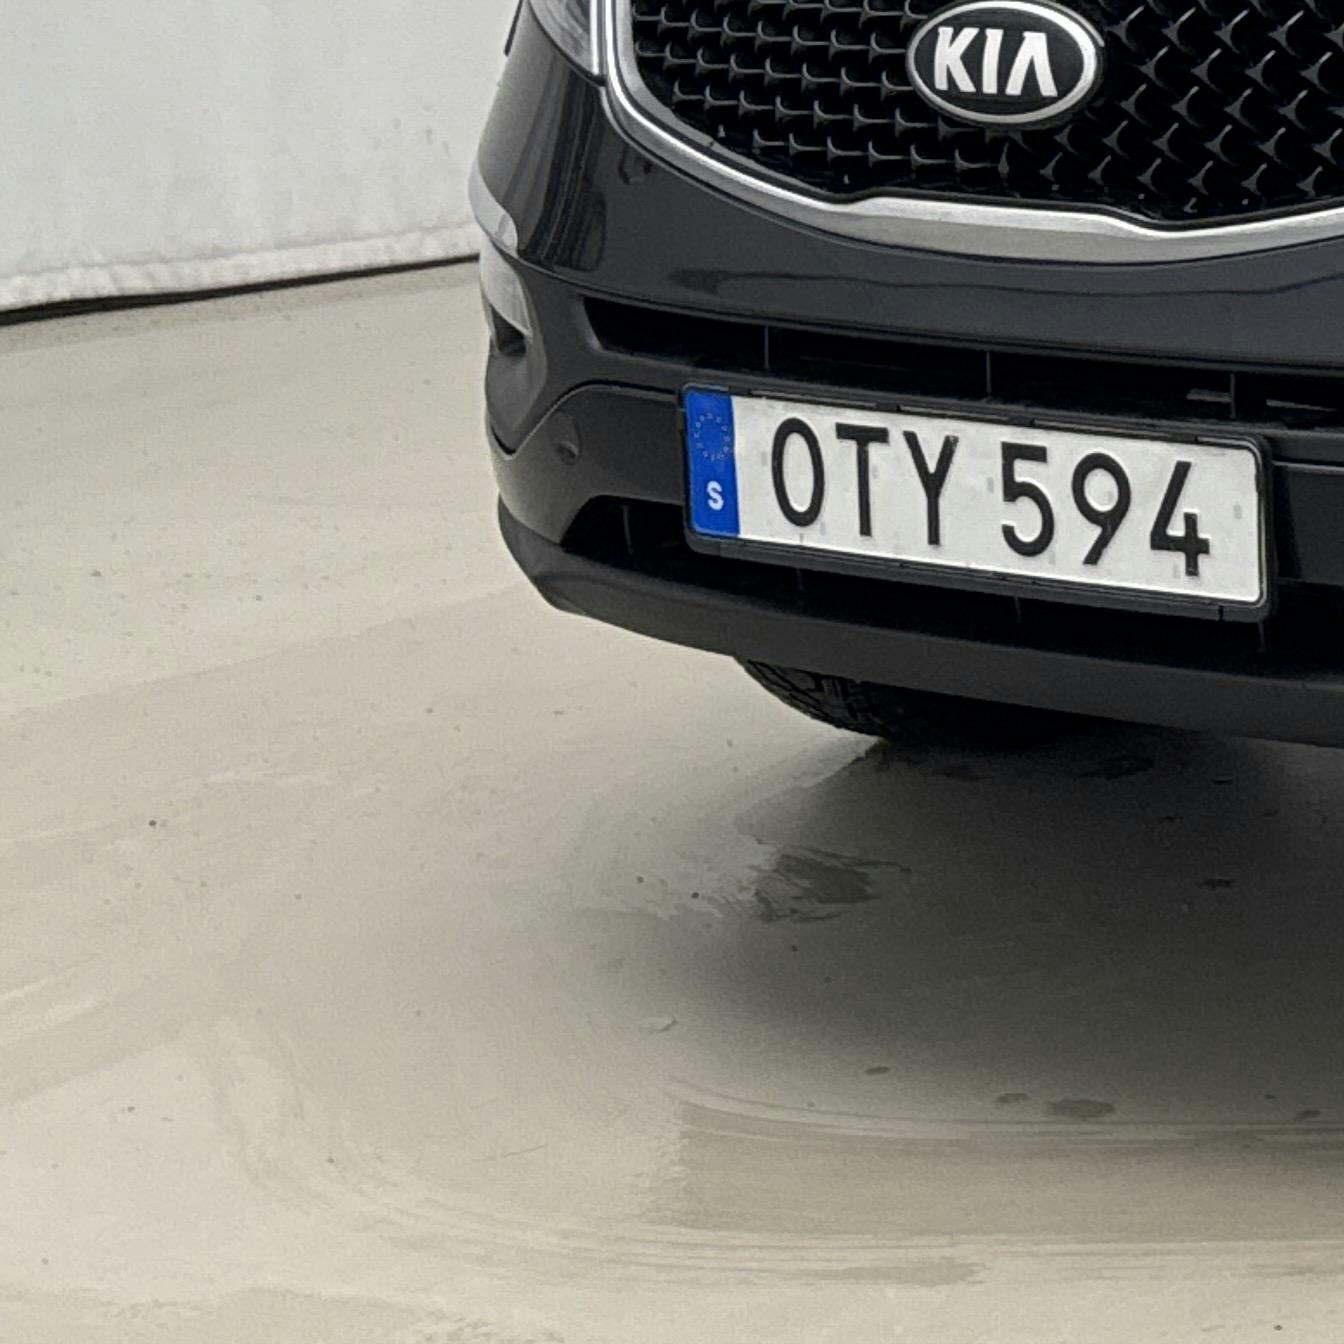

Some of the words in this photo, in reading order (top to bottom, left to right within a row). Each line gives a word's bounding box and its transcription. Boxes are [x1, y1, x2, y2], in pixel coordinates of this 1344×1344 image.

[933, 26, 1059, 98] KIA
[706, 480, 726, 512] S
[771, 416, 960, 547] OTY
[1000, 440, 1211, 578] 594
